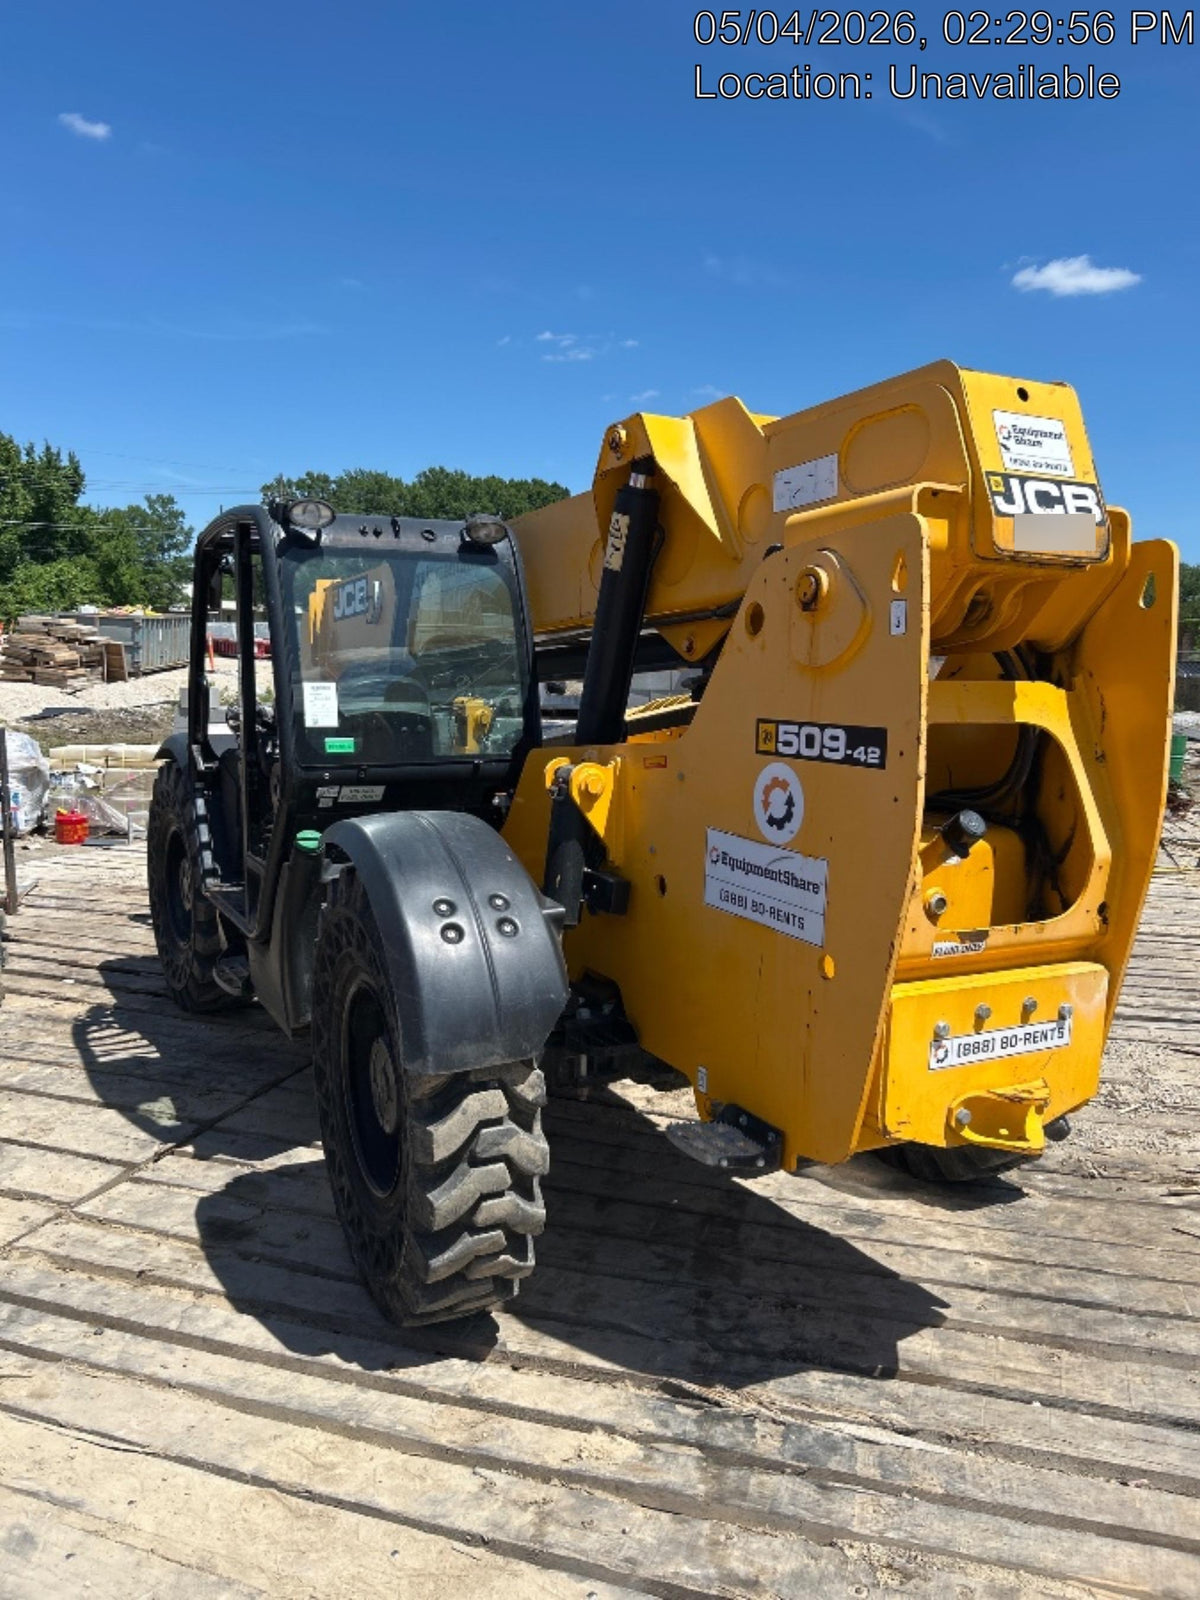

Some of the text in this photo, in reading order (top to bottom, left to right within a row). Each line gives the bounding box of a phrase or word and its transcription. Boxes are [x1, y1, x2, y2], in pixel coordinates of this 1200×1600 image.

[993, 477, 1103, 524] JCB
[777, 724, 881, 763] 509-42
[720, 850, 820, 895] EquipmentShare
[719, 888, 805, 931] (888) 80-RENTS
[957, 1026, 1065, 1058] (888) 80-RENTS
